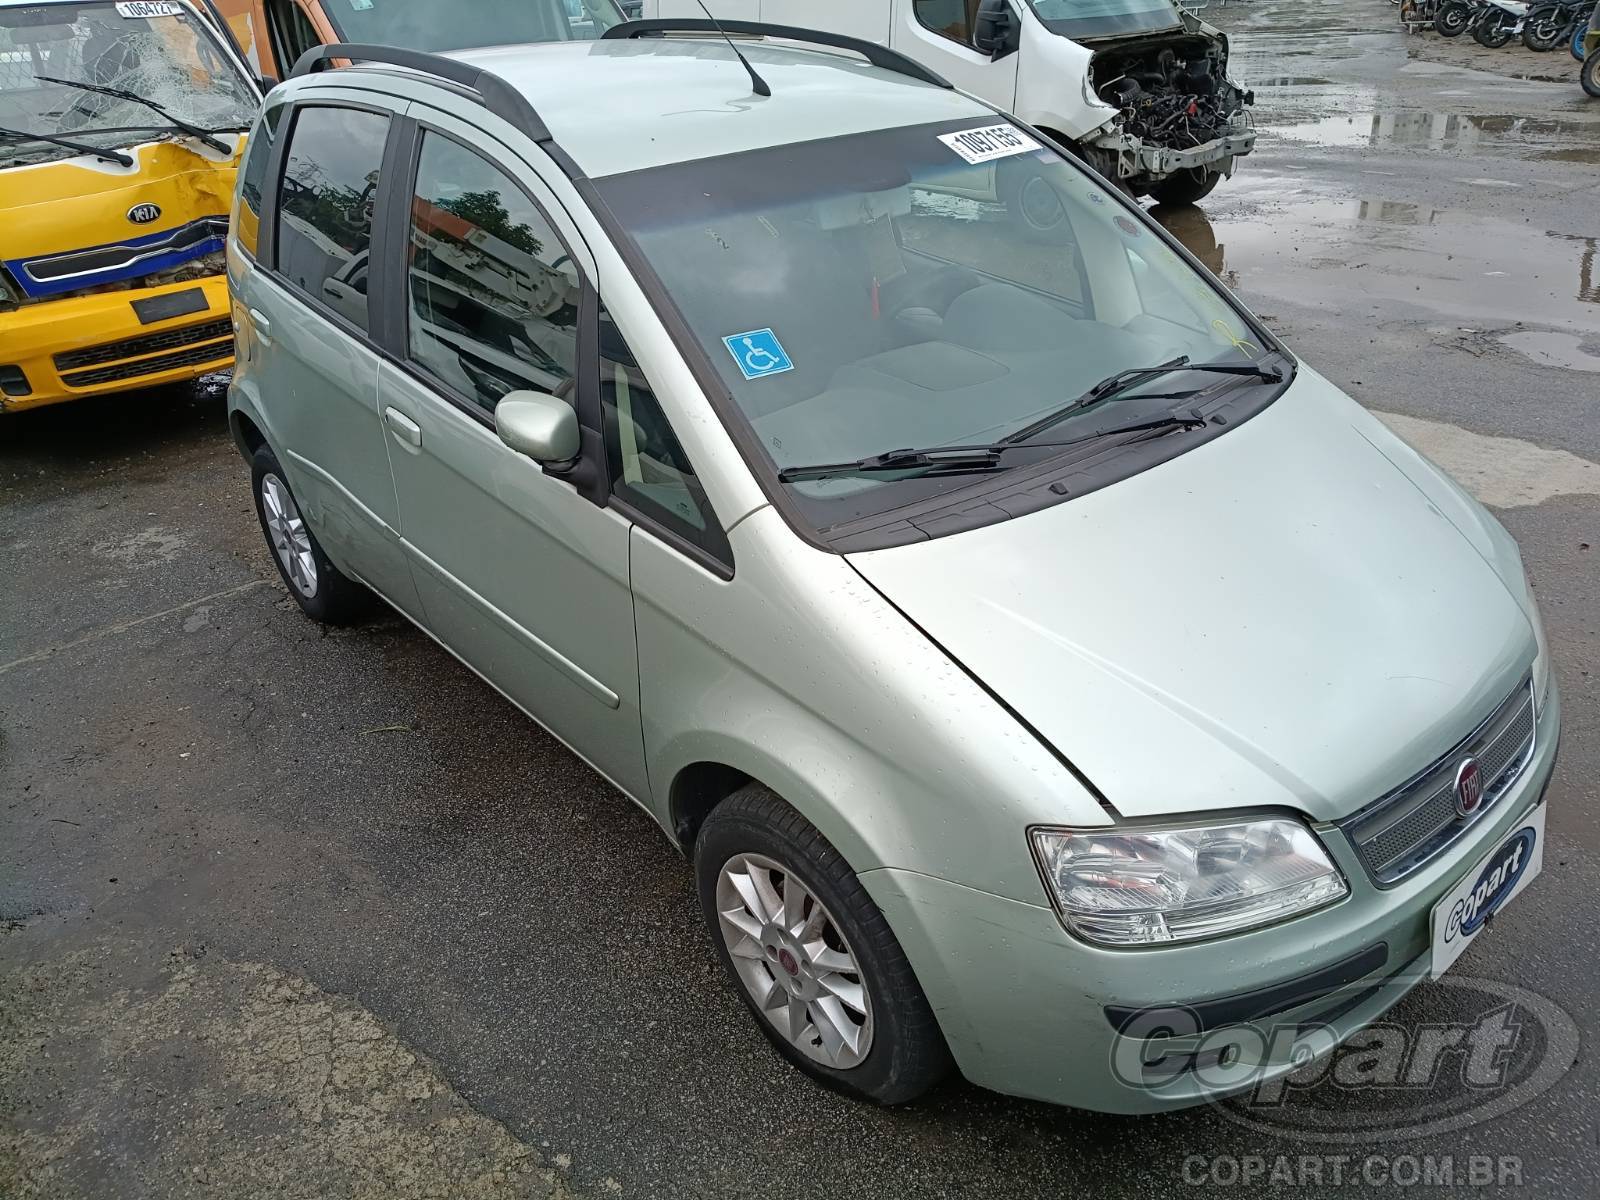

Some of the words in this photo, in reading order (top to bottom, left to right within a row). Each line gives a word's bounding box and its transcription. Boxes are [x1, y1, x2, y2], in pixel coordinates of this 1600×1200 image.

[124, 2, 174, 16] 1064727
[954, 127, 1023, 155] 1097155
[133, 206, 159, 222] KIA
[1461, 770, 1478, 804] FIAT
[1445, 839, 1524, 943] Copart
